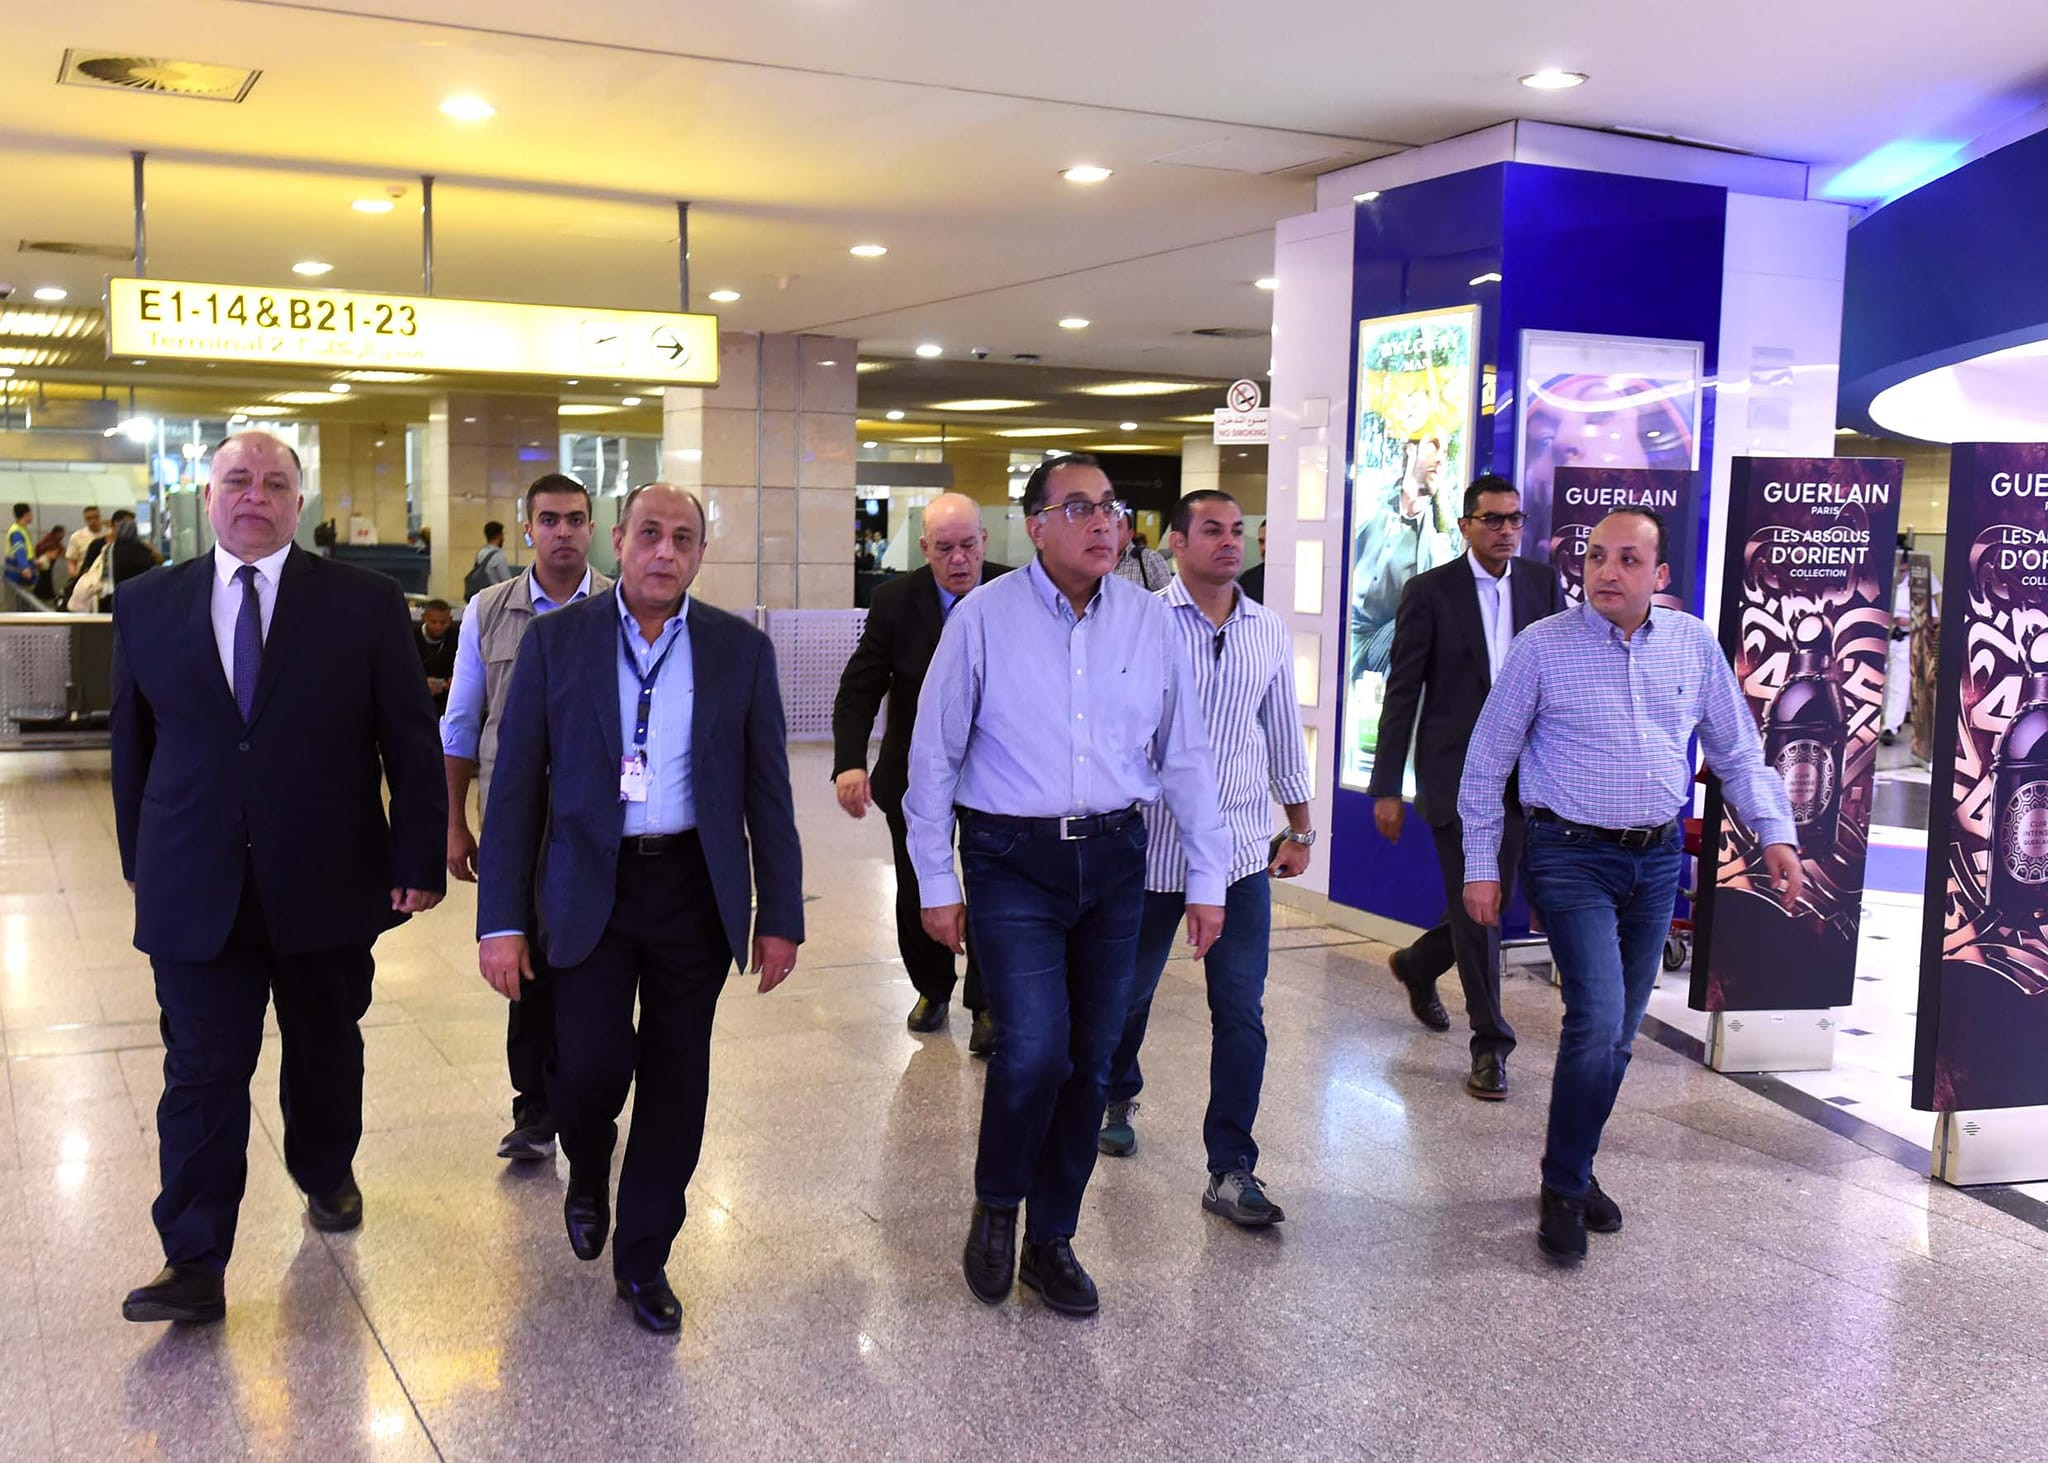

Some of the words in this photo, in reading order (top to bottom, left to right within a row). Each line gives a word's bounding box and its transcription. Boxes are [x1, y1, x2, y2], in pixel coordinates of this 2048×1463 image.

[1219, 429, 1230, 437] NO
[1232, 429, 1267, 437] SMOKING
[1565, 487, 1677, 506] GUERLAIN
[1763, 482, 1889, 504] GUERLAIN
[1811, 506, 1840, 515] PARIS
[1773, 530, 1800, 543] LES
[1802, 530, 1870, 543] ABSOLUS
[2002, 529, 2032, 545] LES
[1771, 546, 1869, 565] D'ORIENT
[1790, 569, 1847, 577] COLLECTION
